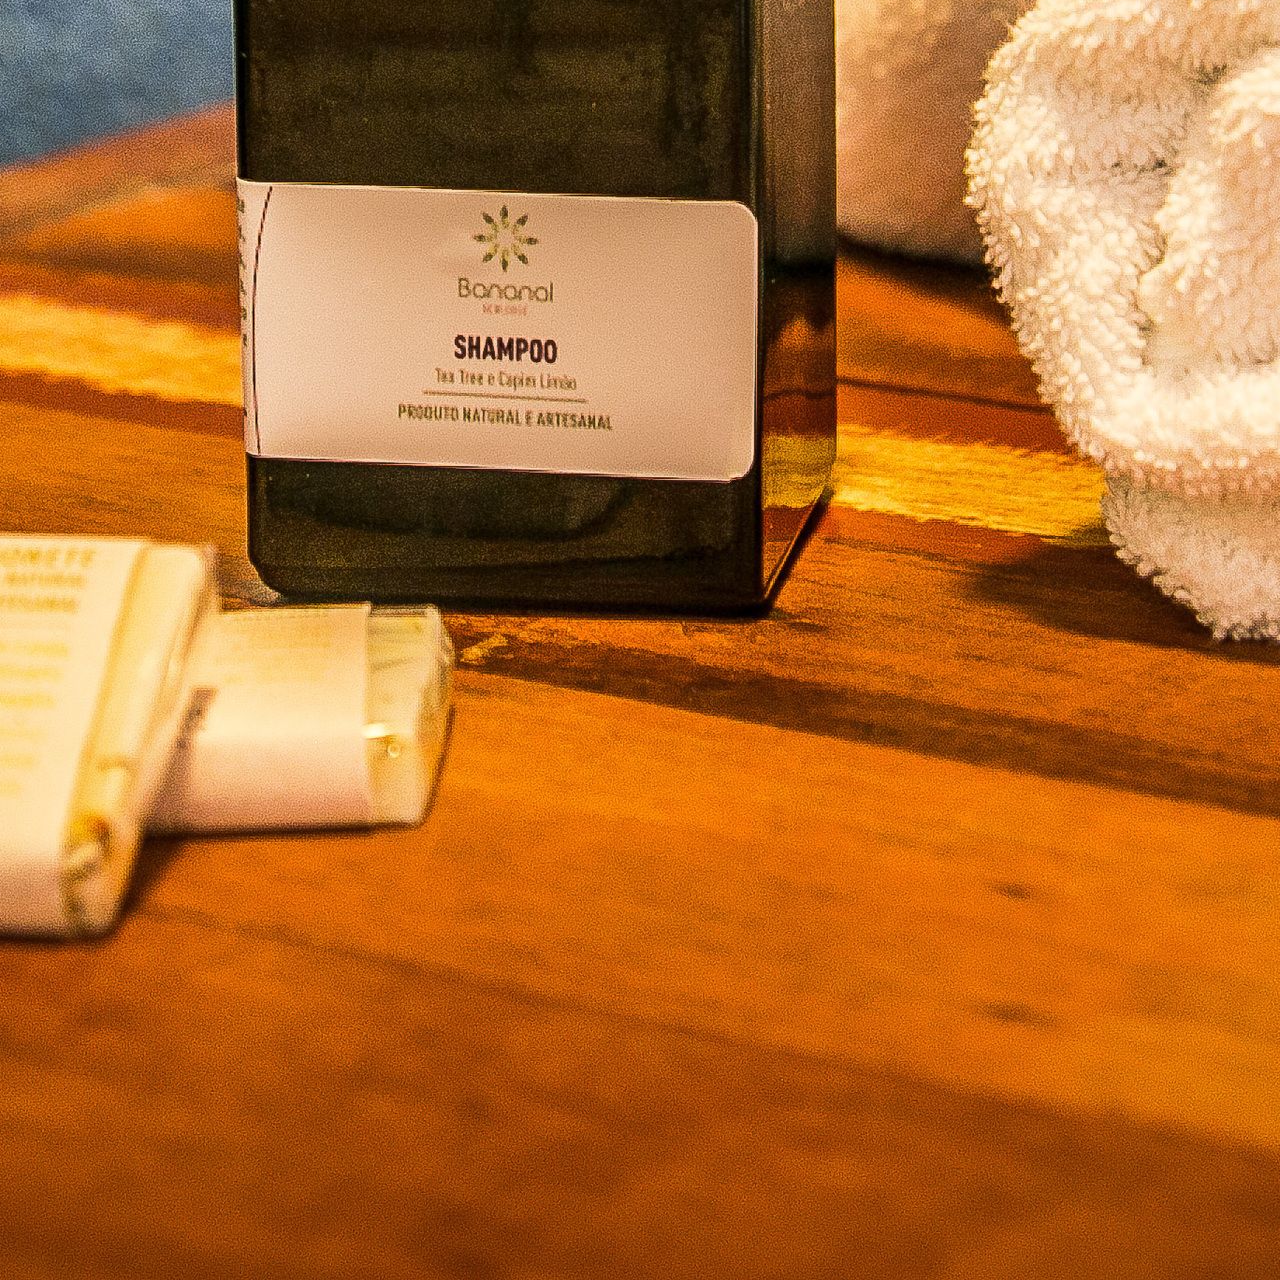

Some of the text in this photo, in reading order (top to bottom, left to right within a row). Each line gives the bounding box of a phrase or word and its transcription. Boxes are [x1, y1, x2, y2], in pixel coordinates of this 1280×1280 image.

[458, 277, 554, 303] Bananal
[454, 334, 557, 364] SHAMPOO
[398, 403, 613, 431] PRODUTO NATURAL E ARTESANAL
